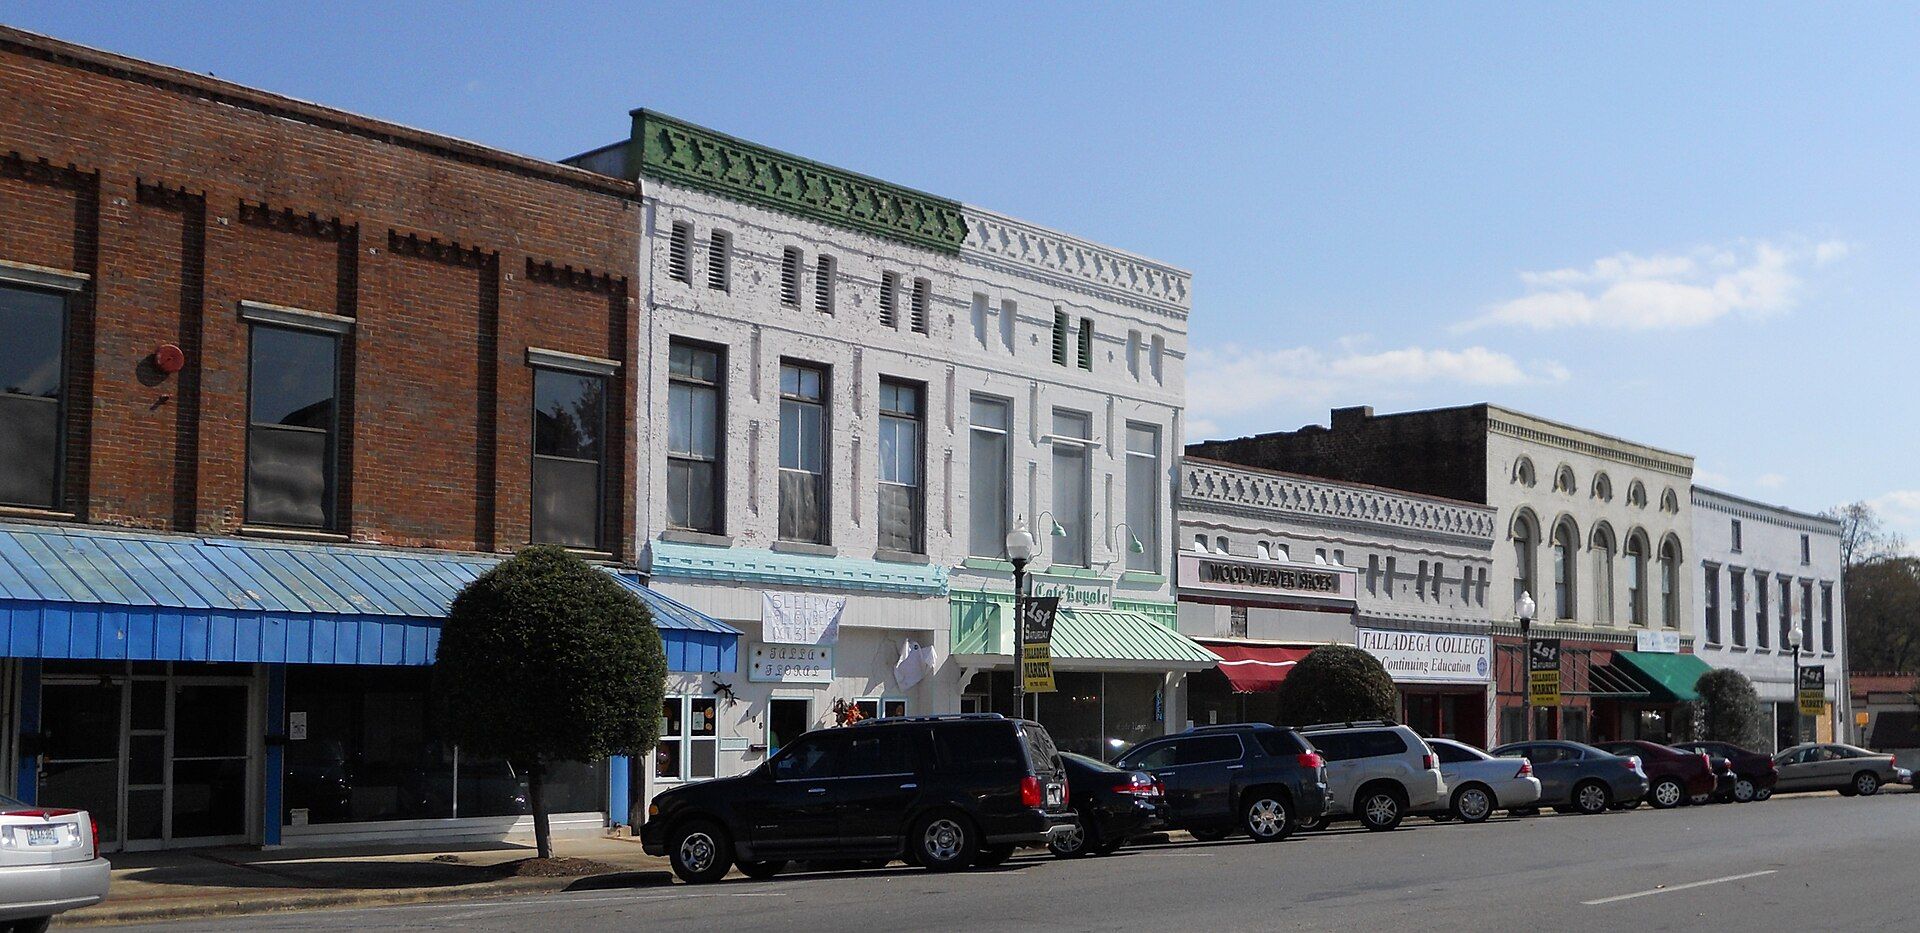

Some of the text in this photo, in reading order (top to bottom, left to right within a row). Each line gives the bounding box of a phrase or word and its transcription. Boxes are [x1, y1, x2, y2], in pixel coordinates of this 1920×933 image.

[1210, 562, 1331, 591] WOOD-WEAVER SHOES
[773, 595, 830, 611] SLEEPY
[1027, 601, 1051, 627] 1st
[1363, 632, 1486, 655] TALLADEGA COLLEGE
[1533, 641, 1556, 660] 1st
[765, 664, 820, 677] FLORAL
[1024, 661, 1051, 678] MARKET
[1382, 656, 1471, 675] Continuing Education
[1531, 683, 1558, 695] MARKET
